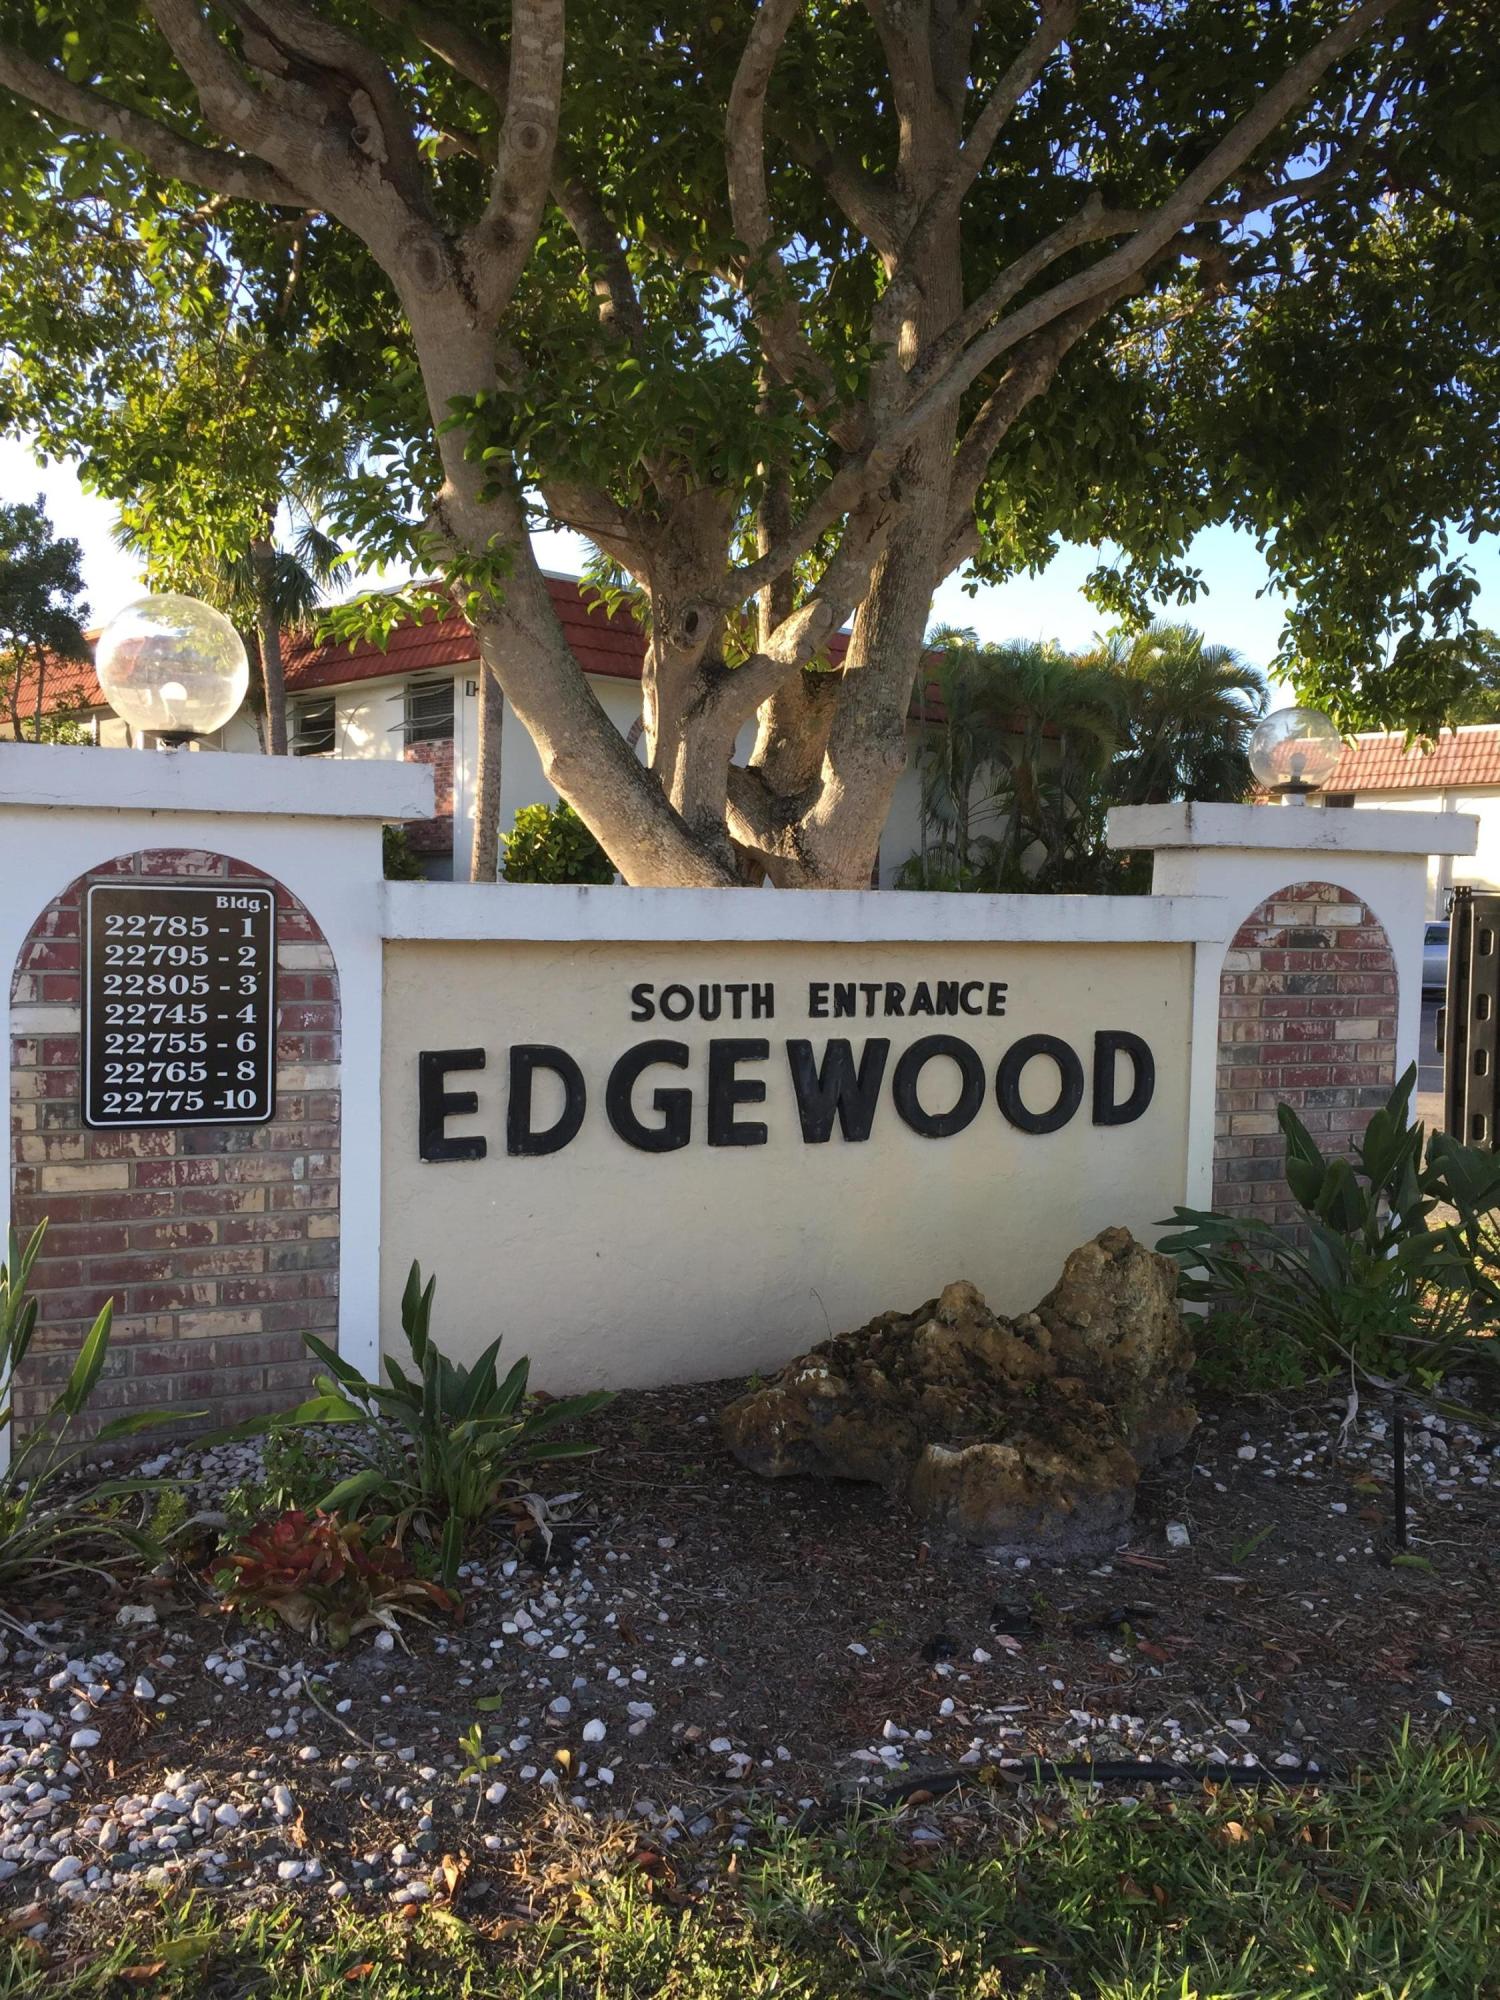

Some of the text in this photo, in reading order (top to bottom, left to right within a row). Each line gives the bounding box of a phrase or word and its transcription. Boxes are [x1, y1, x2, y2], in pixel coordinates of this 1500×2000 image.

[216, 896, 269, 912] Bldg.
[105, 915, 209, 937] 22785
[241, 918, 255, 938] 1
[105, 944, 209, 967] 22795
[238, 946, 256, 967] 2
[103, 975, 210, 996] 22805
[238, 975, 257, 995] 3
[631, 981, 1008, 1022] SOUTH ENTRANCE
[105, 1003, 208, 1025] 22745
[236, 1004, 256, 1024] 4
[105, 1032, 207, 1054] 22755
[236, 1032, 256, 1053] 6
[104, 1061, 207, 1084] 22765
[237, 1061, 256, 1081] 8
[103, 1090, 204, 1113] 22775
[418, 1030, 1156, 1163] EDGEWOOD
